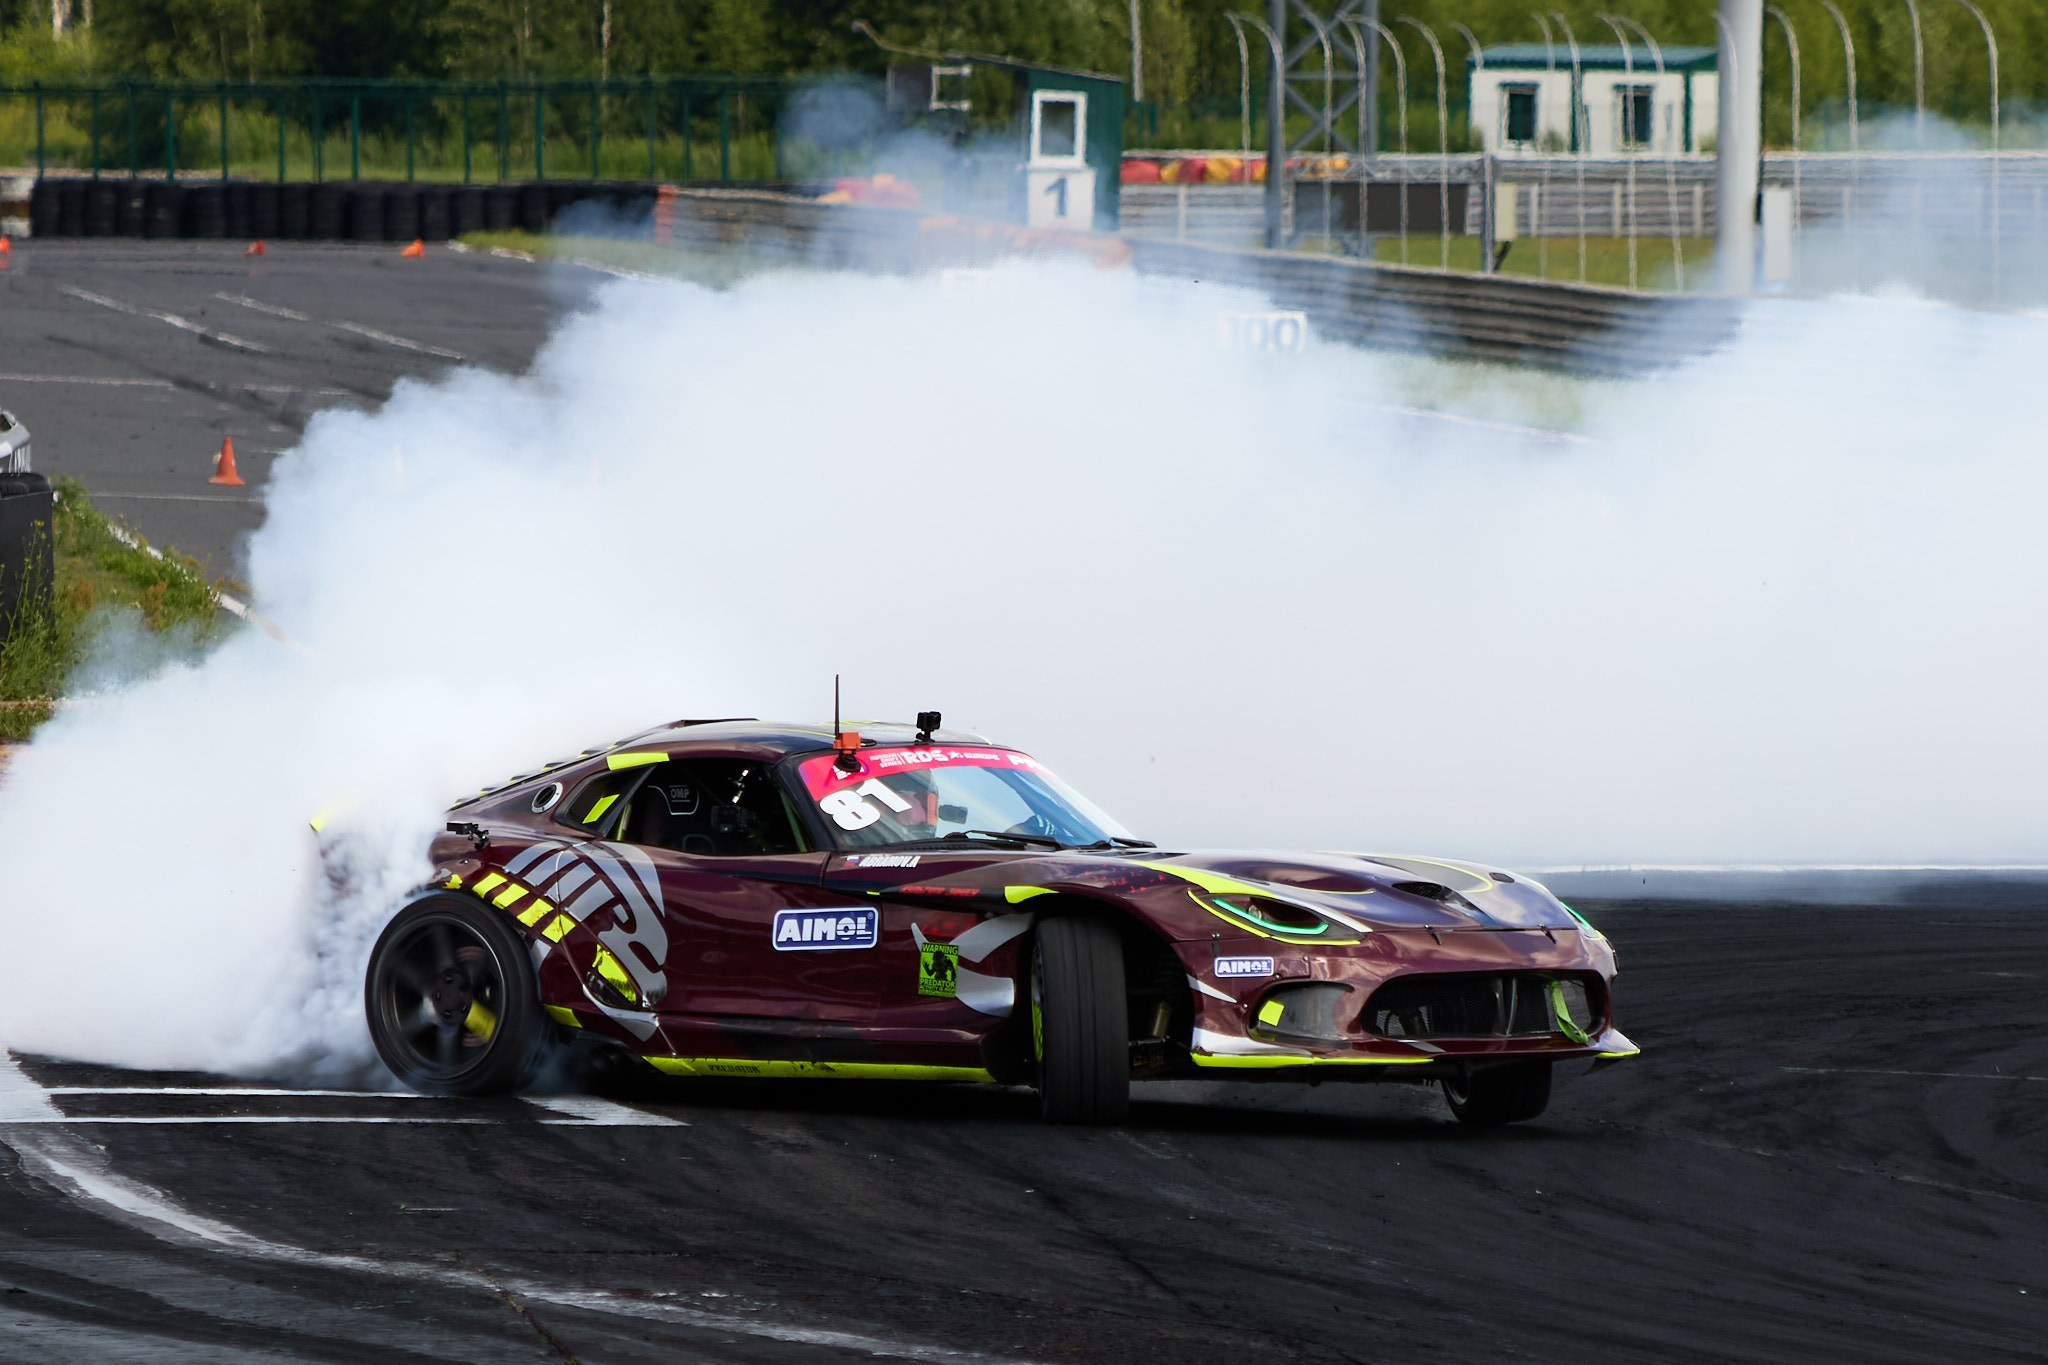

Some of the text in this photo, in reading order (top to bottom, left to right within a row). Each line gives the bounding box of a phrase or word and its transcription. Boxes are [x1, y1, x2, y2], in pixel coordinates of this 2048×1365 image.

[1045, 176, 1067, 217] 1
[905, 749, 950, 764] RDS
[670, 787, 690, 799] OMP
[820, 778, 912, 831] 81
[922, 943, 958, 956] WARNING
[919, 977, 955, 989] PREDATOR
